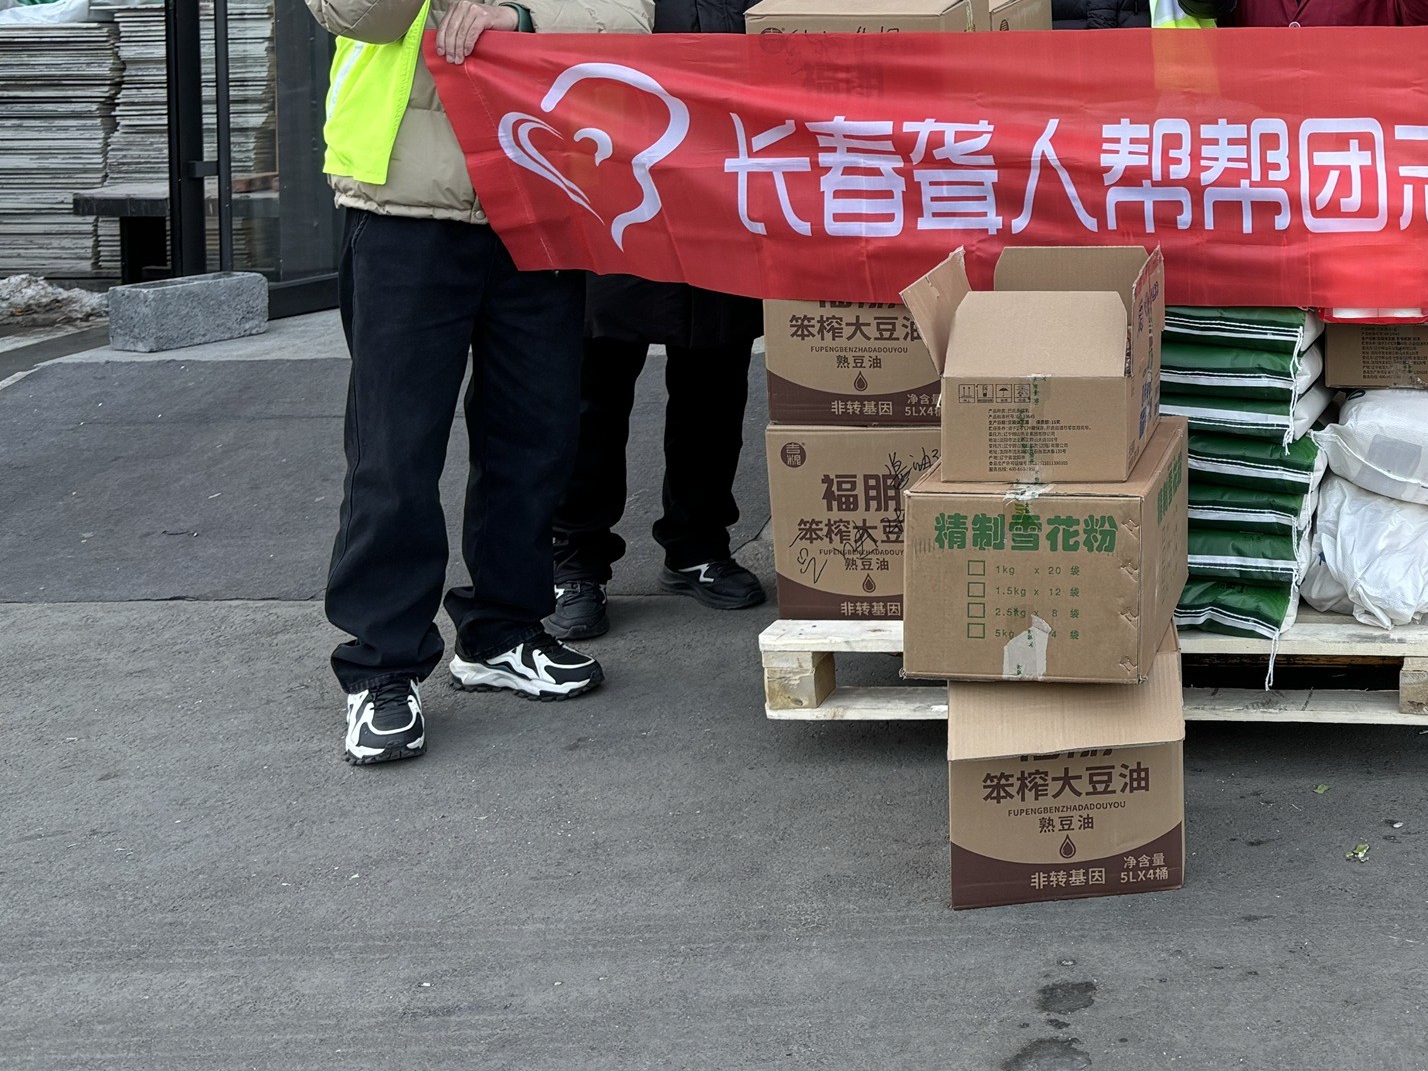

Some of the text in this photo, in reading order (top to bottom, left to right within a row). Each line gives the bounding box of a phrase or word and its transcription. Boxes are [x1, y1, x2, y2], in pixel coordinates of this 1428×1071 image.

[810, 346, 909, 354] FUPENGBENZHADADOUYOU
[836, 355, 882, 369] 熟豆油
[831, 400, 893, 416] 非转基因
[934, 512, 1119, 553] 精制雪花粉
[845, 557, 890, 571] 熟豆油
[995, 565, 1016, 576] 1kg
[1048, 566, 1062, 575] 20
[1069, 565, 1080, 576] 袋
[995, 587, 1027, 597] 1.5kg
[1049, 587, 1062, 596] 12
[1069, 586, 1080, 597] 袋
[840, 601, 901, 617] 非转基因
[1069, 608, 1080, 619] 袋
[994, 629, 1015, 639] 5kg
[1069, 629, 1080, 640] 袋
[982, 761, 1151, 805] 笨榨大豆油
[1008, 800, 1126, 817] FUPENGBENZHADADOUYOU
[1038, 814, 1095, 834] 熟豆油
[1123, 852, 1166, 869] 净含量
[1030, 867, 1107, 889] 非转基因
[1120, 866, 1169, 884] 5LX4桶
